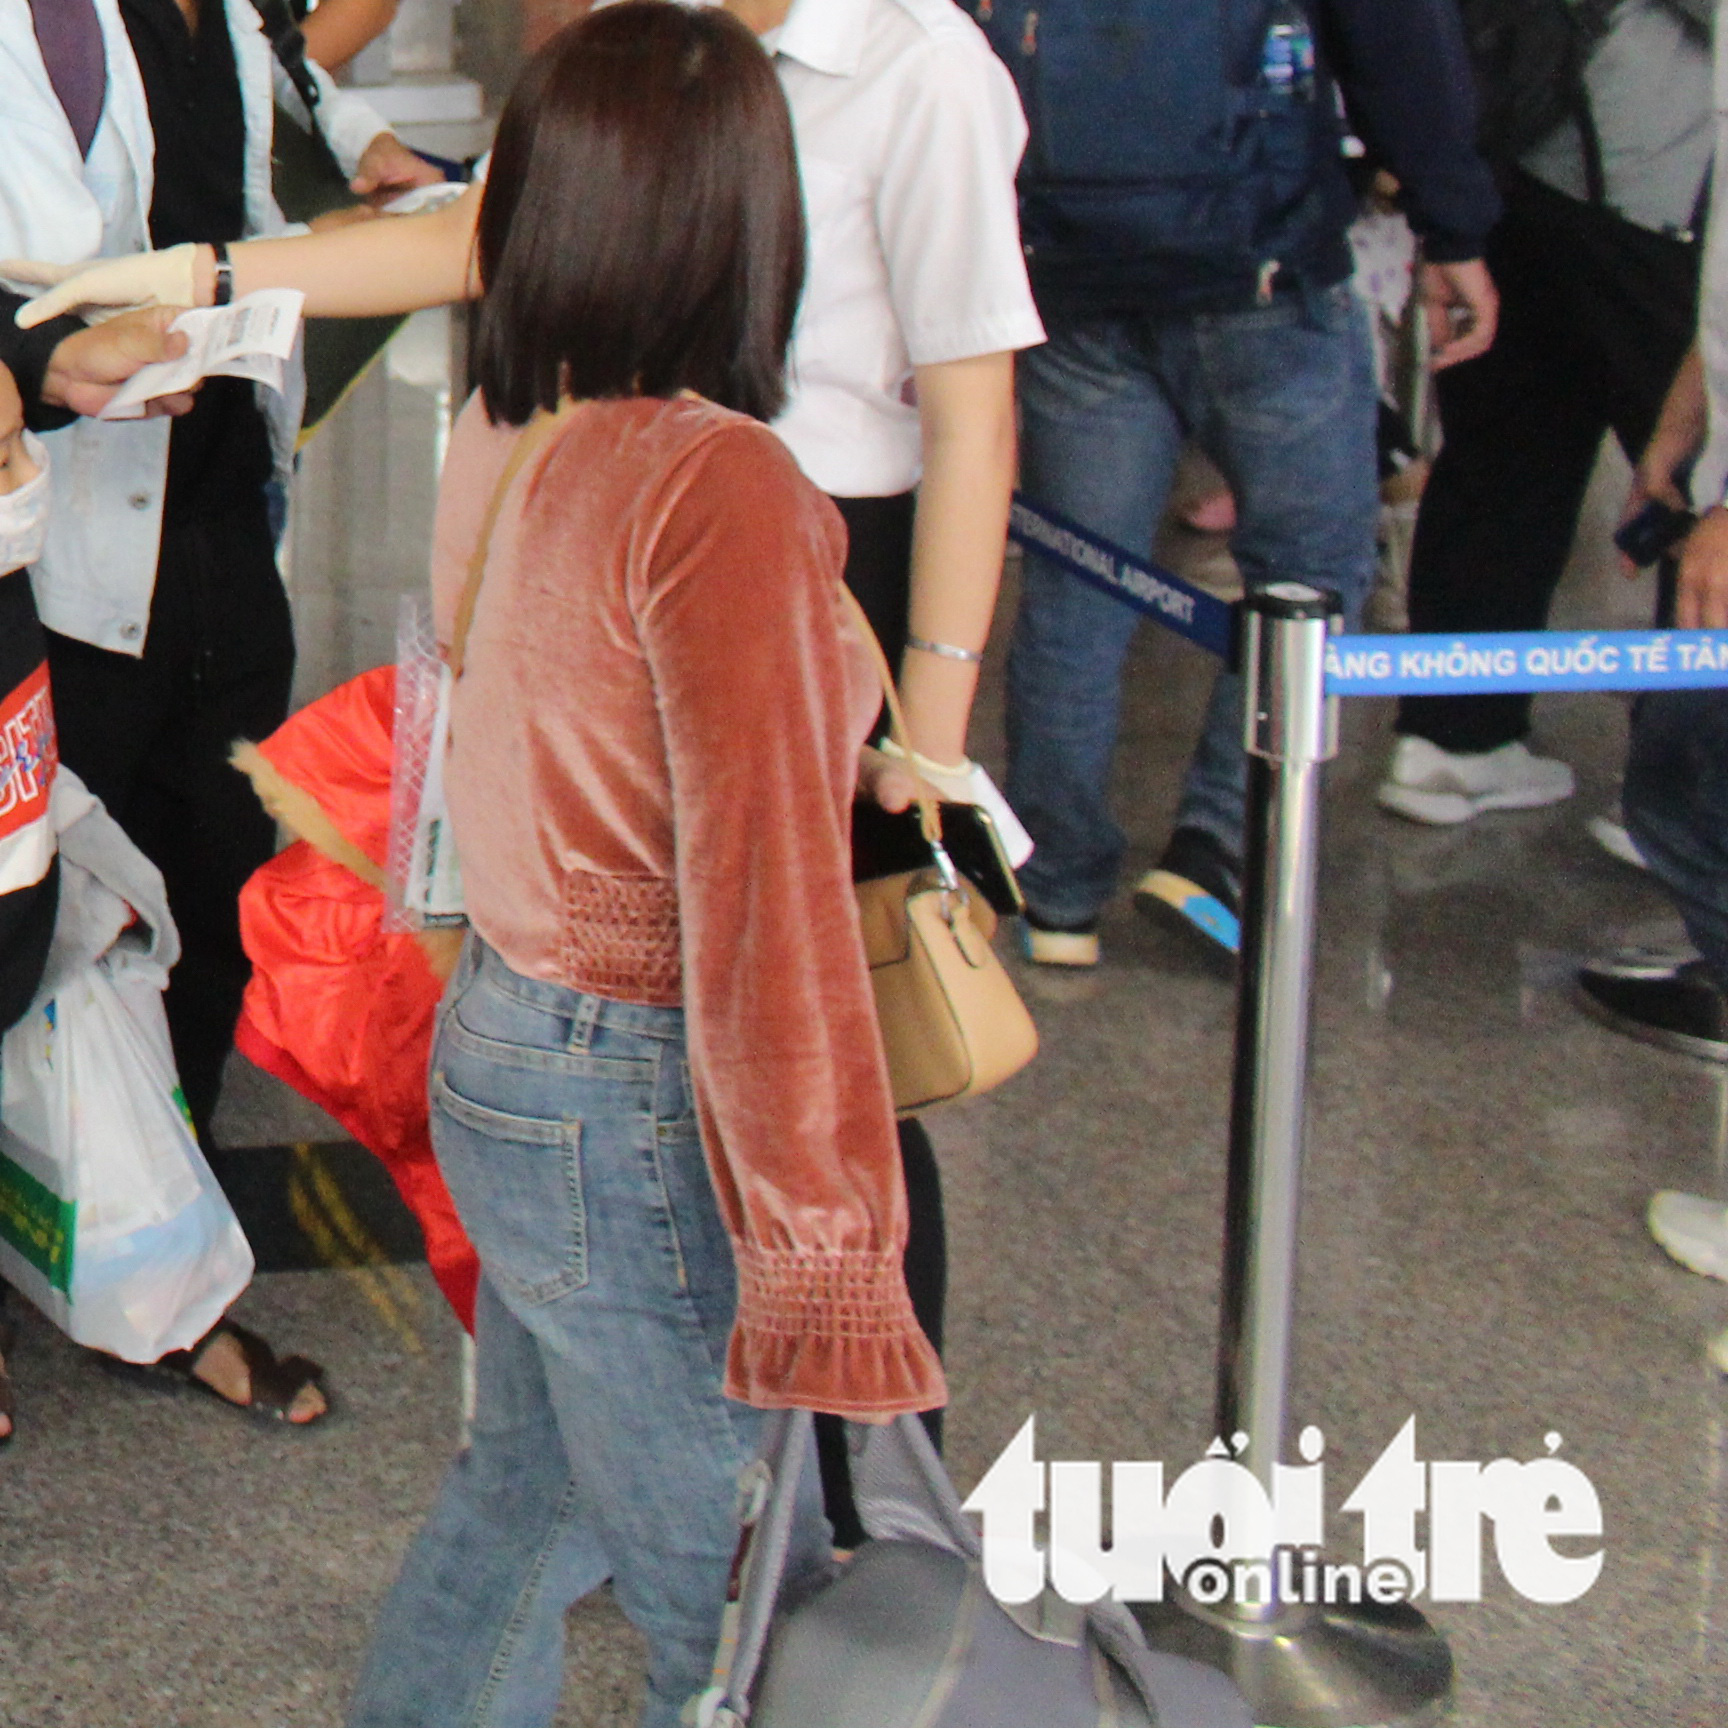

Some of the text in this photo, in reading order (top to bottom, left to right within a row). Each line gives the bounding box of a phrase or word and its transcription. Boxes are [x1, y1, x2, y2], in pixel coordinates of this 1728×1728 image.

[1325, 643, 1392, 679] ÀNG
[1401, 641, 1517, 679] KHÔNG
[1525, 635, 1620, 676] QUỐC
[1626, 633, 1673, 673] TẾ
